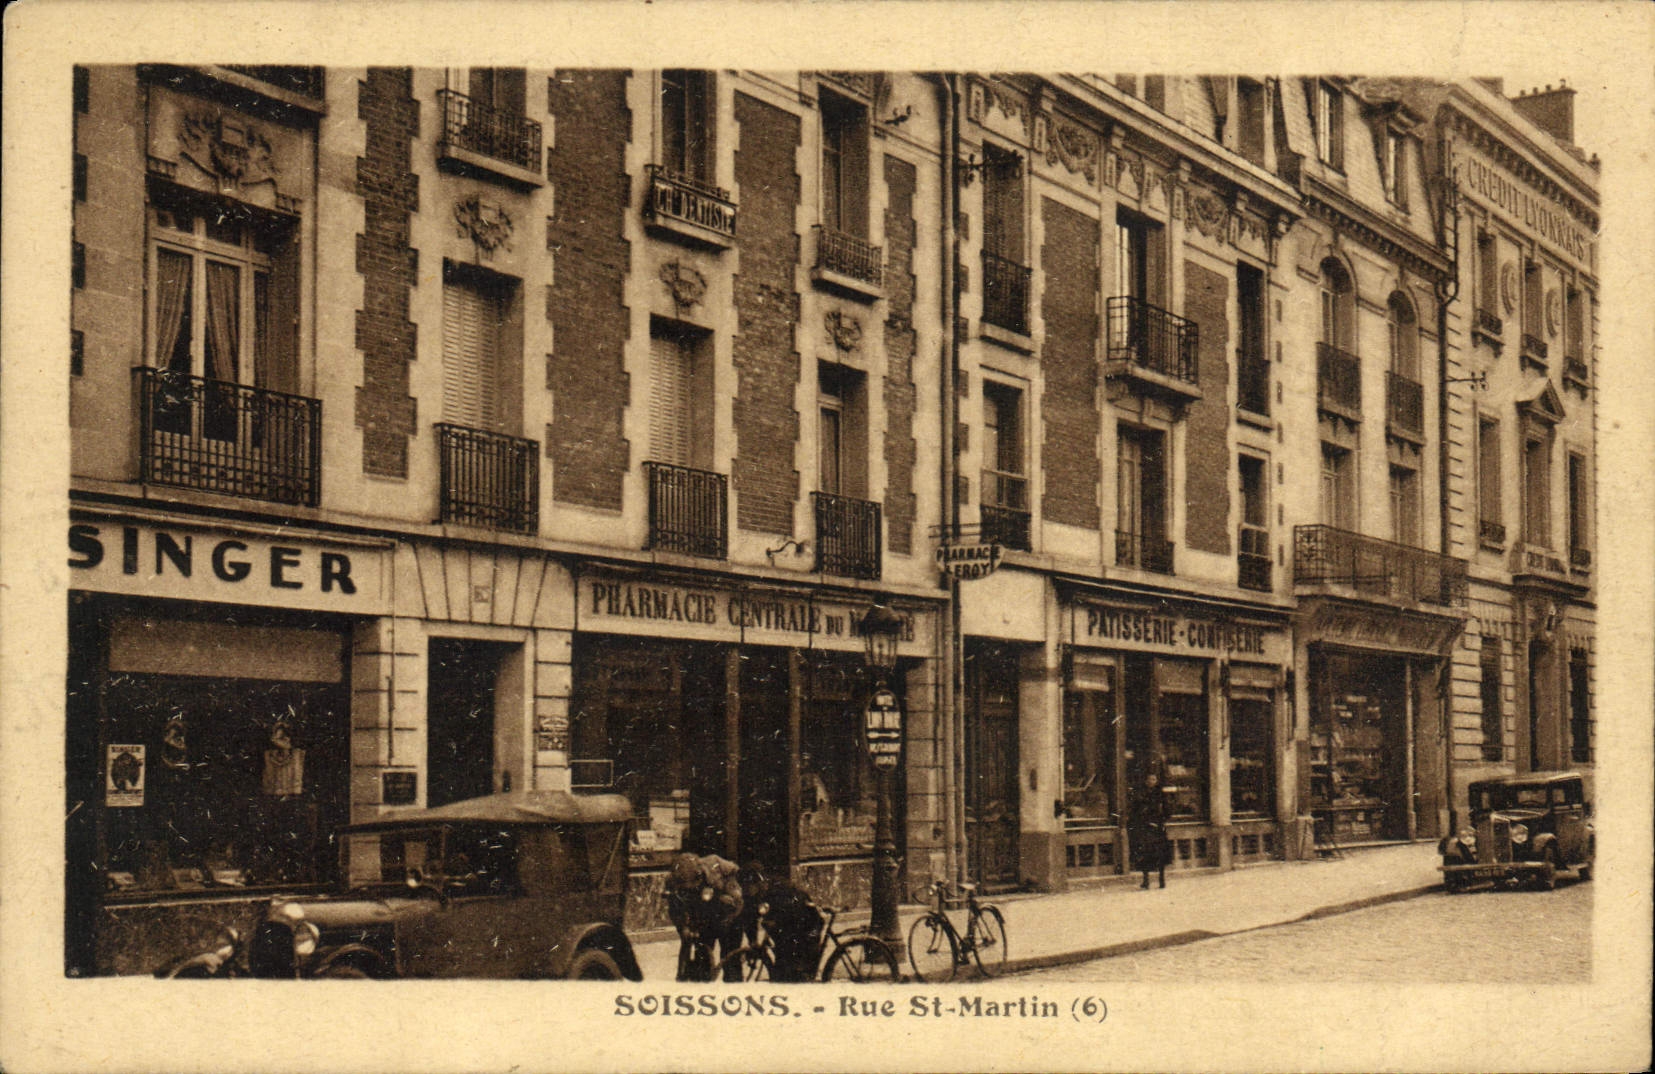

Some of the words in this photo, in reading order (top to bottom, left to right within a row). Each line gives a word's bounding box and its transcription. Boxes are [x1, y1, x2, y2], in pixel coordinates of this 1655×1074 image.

[68, 525, 357, 595] SINGER
[936, 546, 1001, 563] PHARMACE
[592, 581, 717, 624] PHARMACIE
[728, 597, 822, 633] CENTRALE
